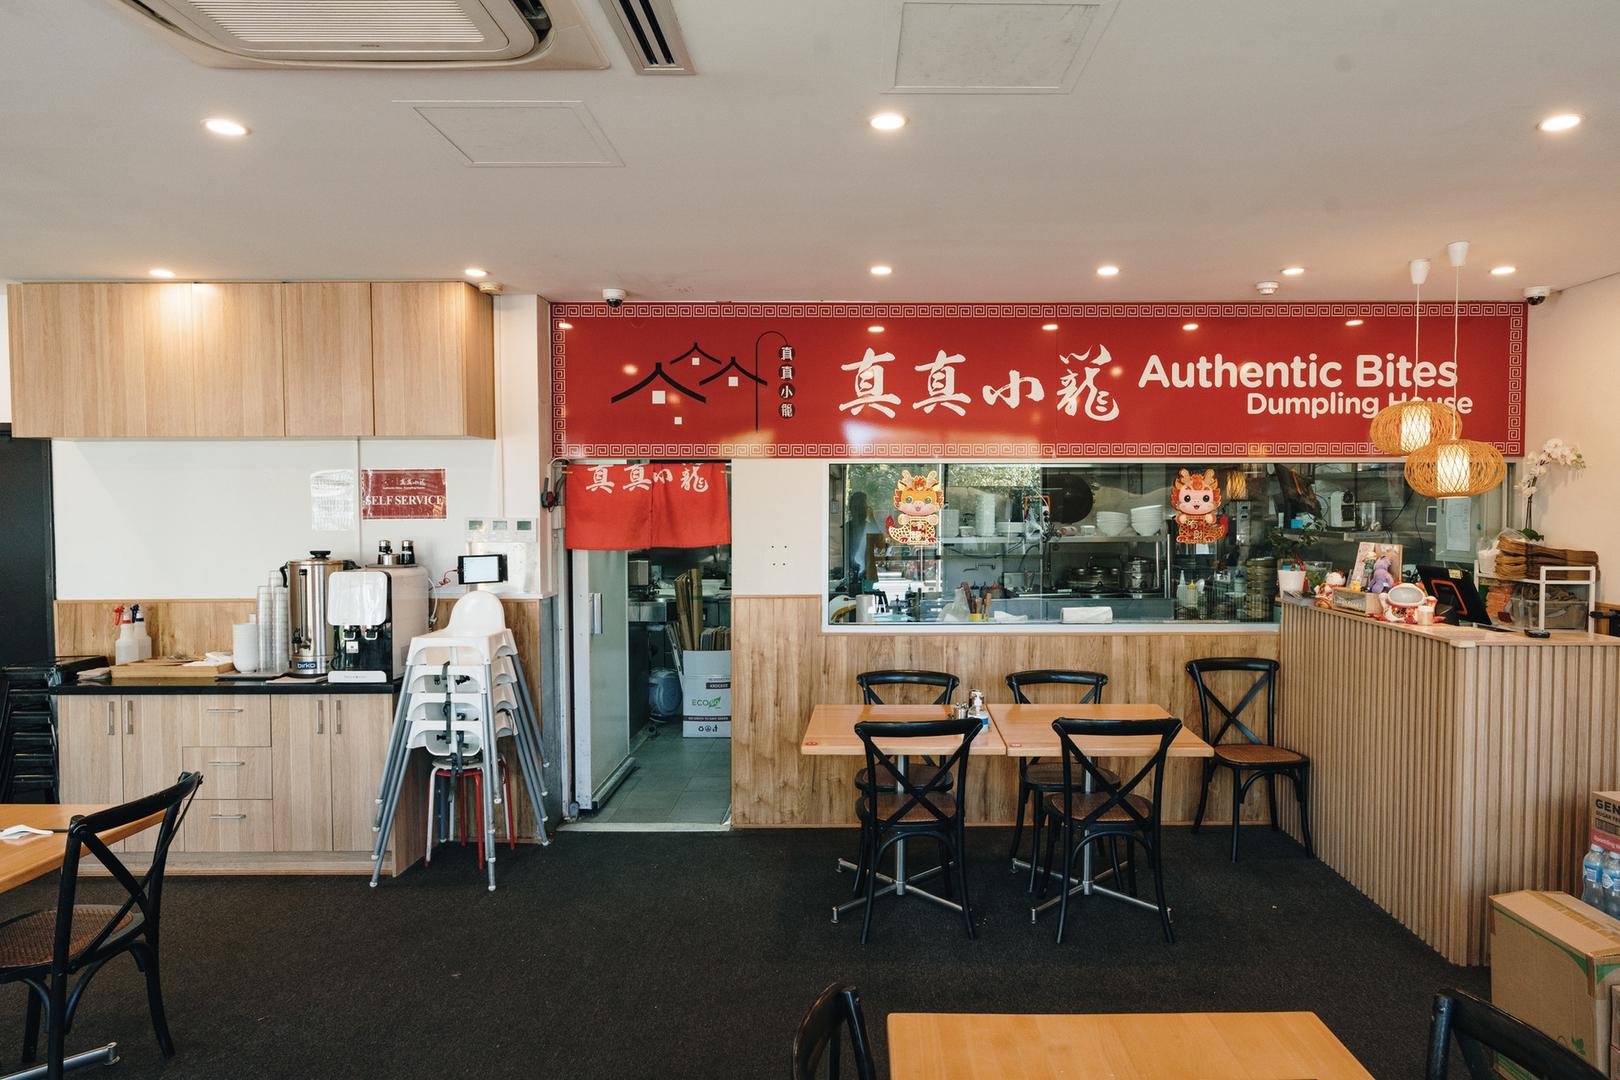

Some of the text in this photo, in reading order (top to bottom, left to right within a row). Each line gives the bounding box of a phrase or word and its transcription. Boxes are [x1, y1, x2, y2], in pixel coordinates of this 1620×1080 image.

[1138, 353, 1458, 388] Authentic Bites
[1247, 392, 1380, 419] Dumpling
[365, 495, 444, 505] SELF SERVICE
